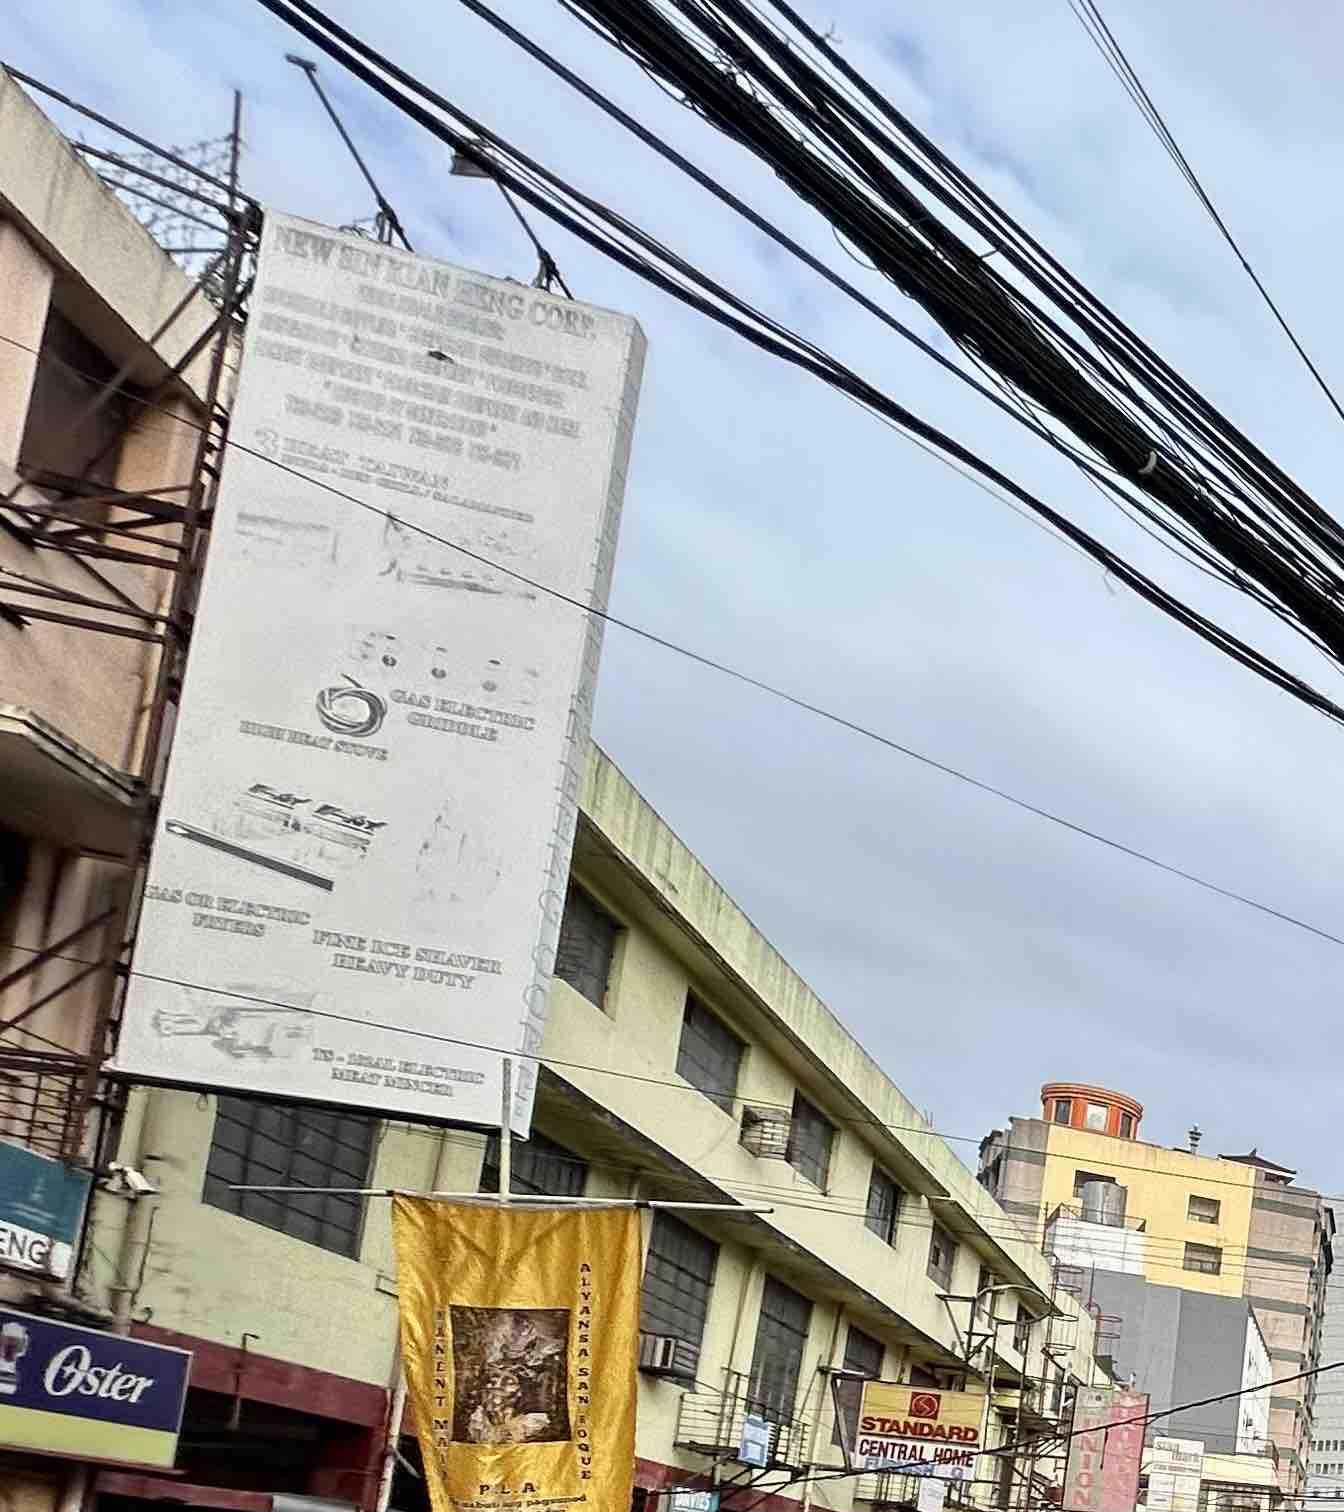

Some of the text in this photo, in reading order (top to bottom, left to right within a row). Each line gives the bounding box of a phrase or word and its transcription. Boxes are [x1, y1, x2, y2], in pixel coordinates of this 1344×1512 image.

[43, 1344, 153, 1404] Oster
[861, 1416, 979, 1441] STANDARD
[859, 1439, 926, 1461] CENTRAL
[932, 1446, 975, 1468] HOME
